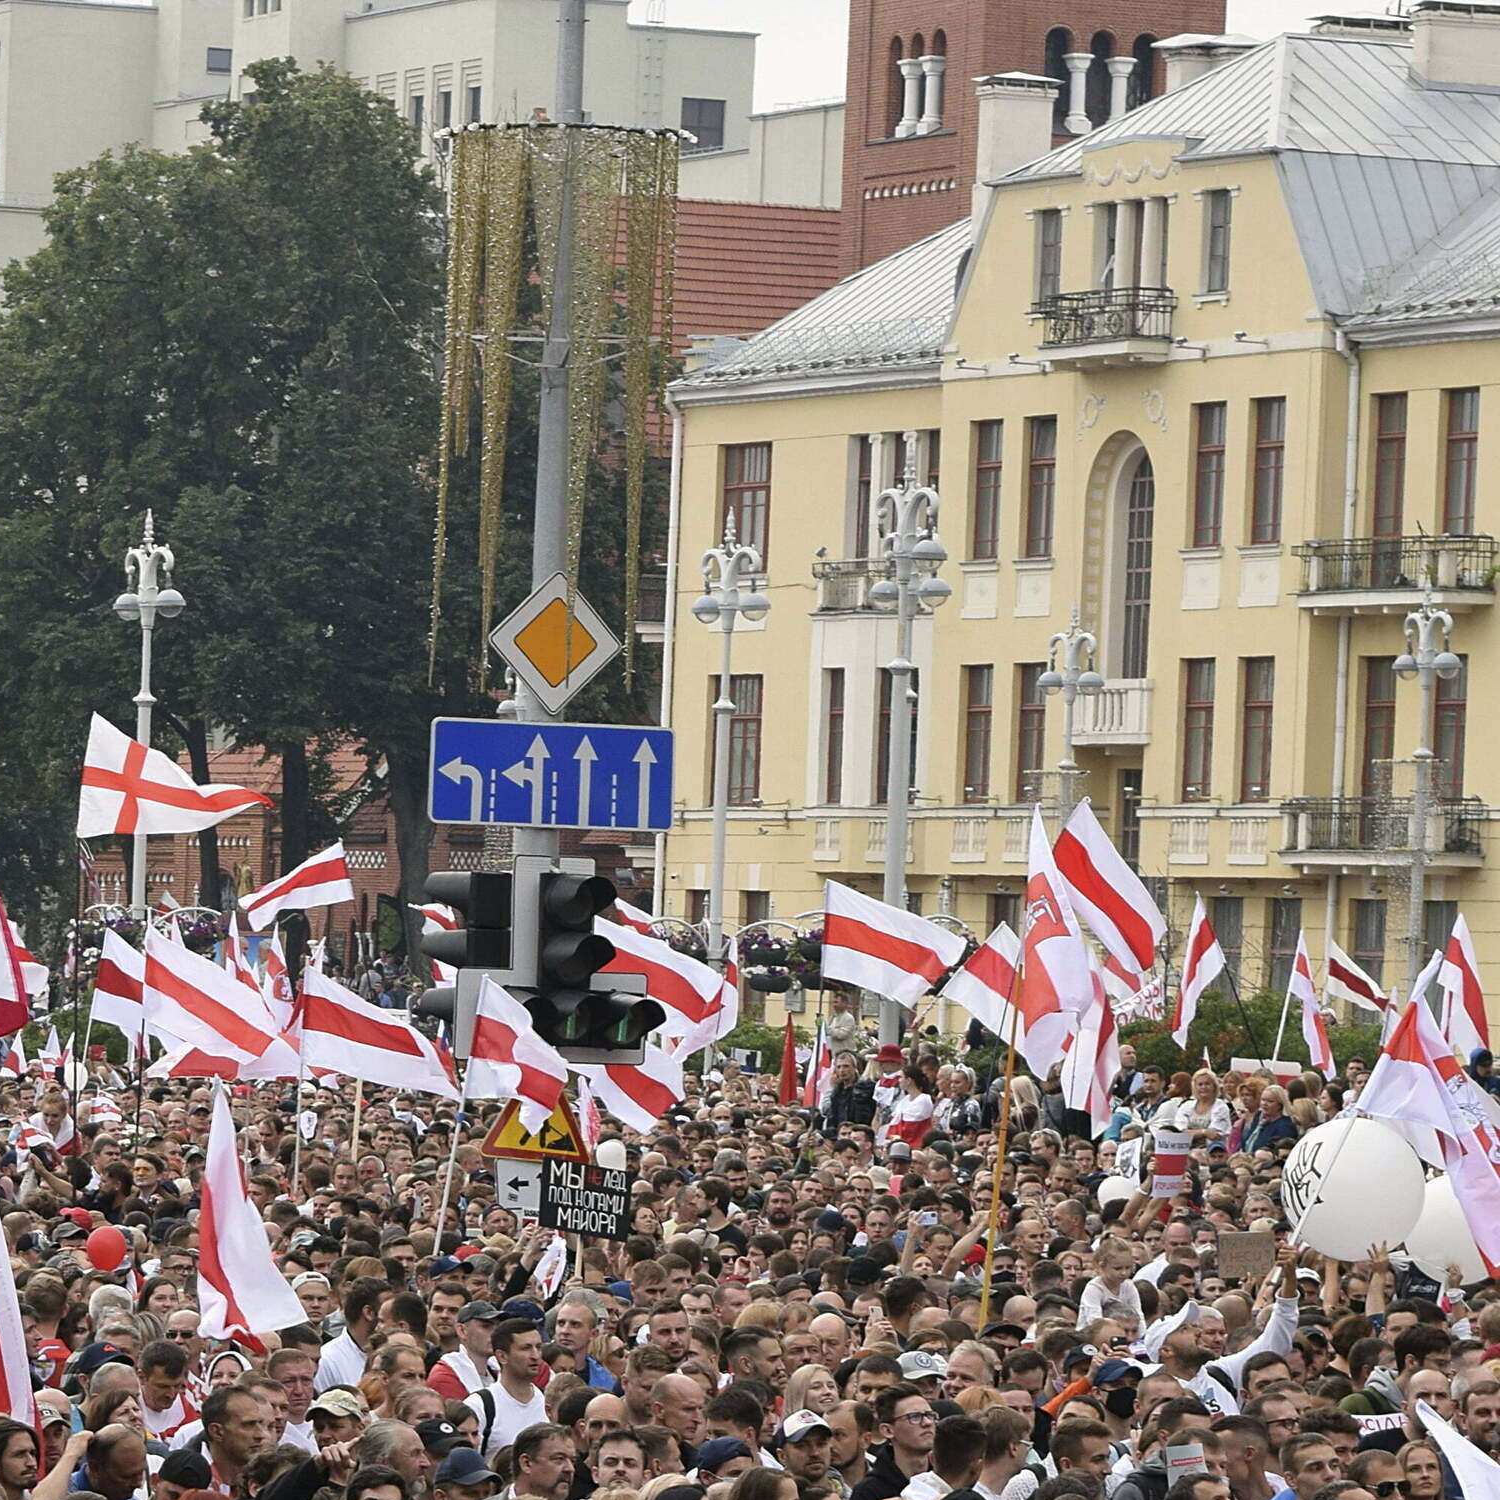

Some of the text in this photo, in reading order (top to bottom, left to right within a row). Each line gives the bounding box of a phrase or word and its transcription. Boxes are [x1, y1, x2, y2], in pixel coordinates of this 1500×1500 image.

[550, 1159, 585, 1190] МЫ
[548, 1185, 625, 1215] ПОД НОГАМИ
[557, 1206, 617, 1235] МАЙОРА
